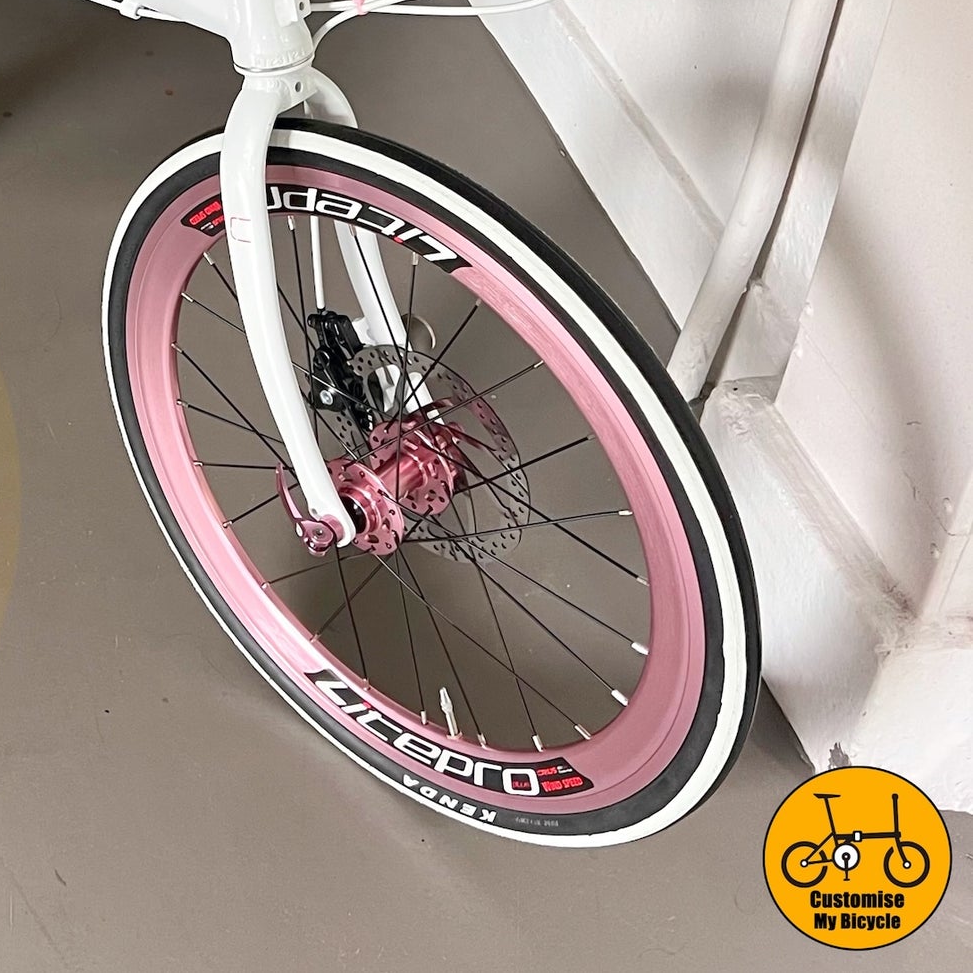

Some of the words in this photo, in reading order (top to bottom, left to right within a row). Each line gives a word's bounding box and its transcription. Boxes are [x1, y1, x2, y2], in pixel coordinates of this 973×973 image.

[267, 186, 458, 262] Litepr
[315, 680, 540, 796] Litepro
[402, 774, 498, 823] KENDA
